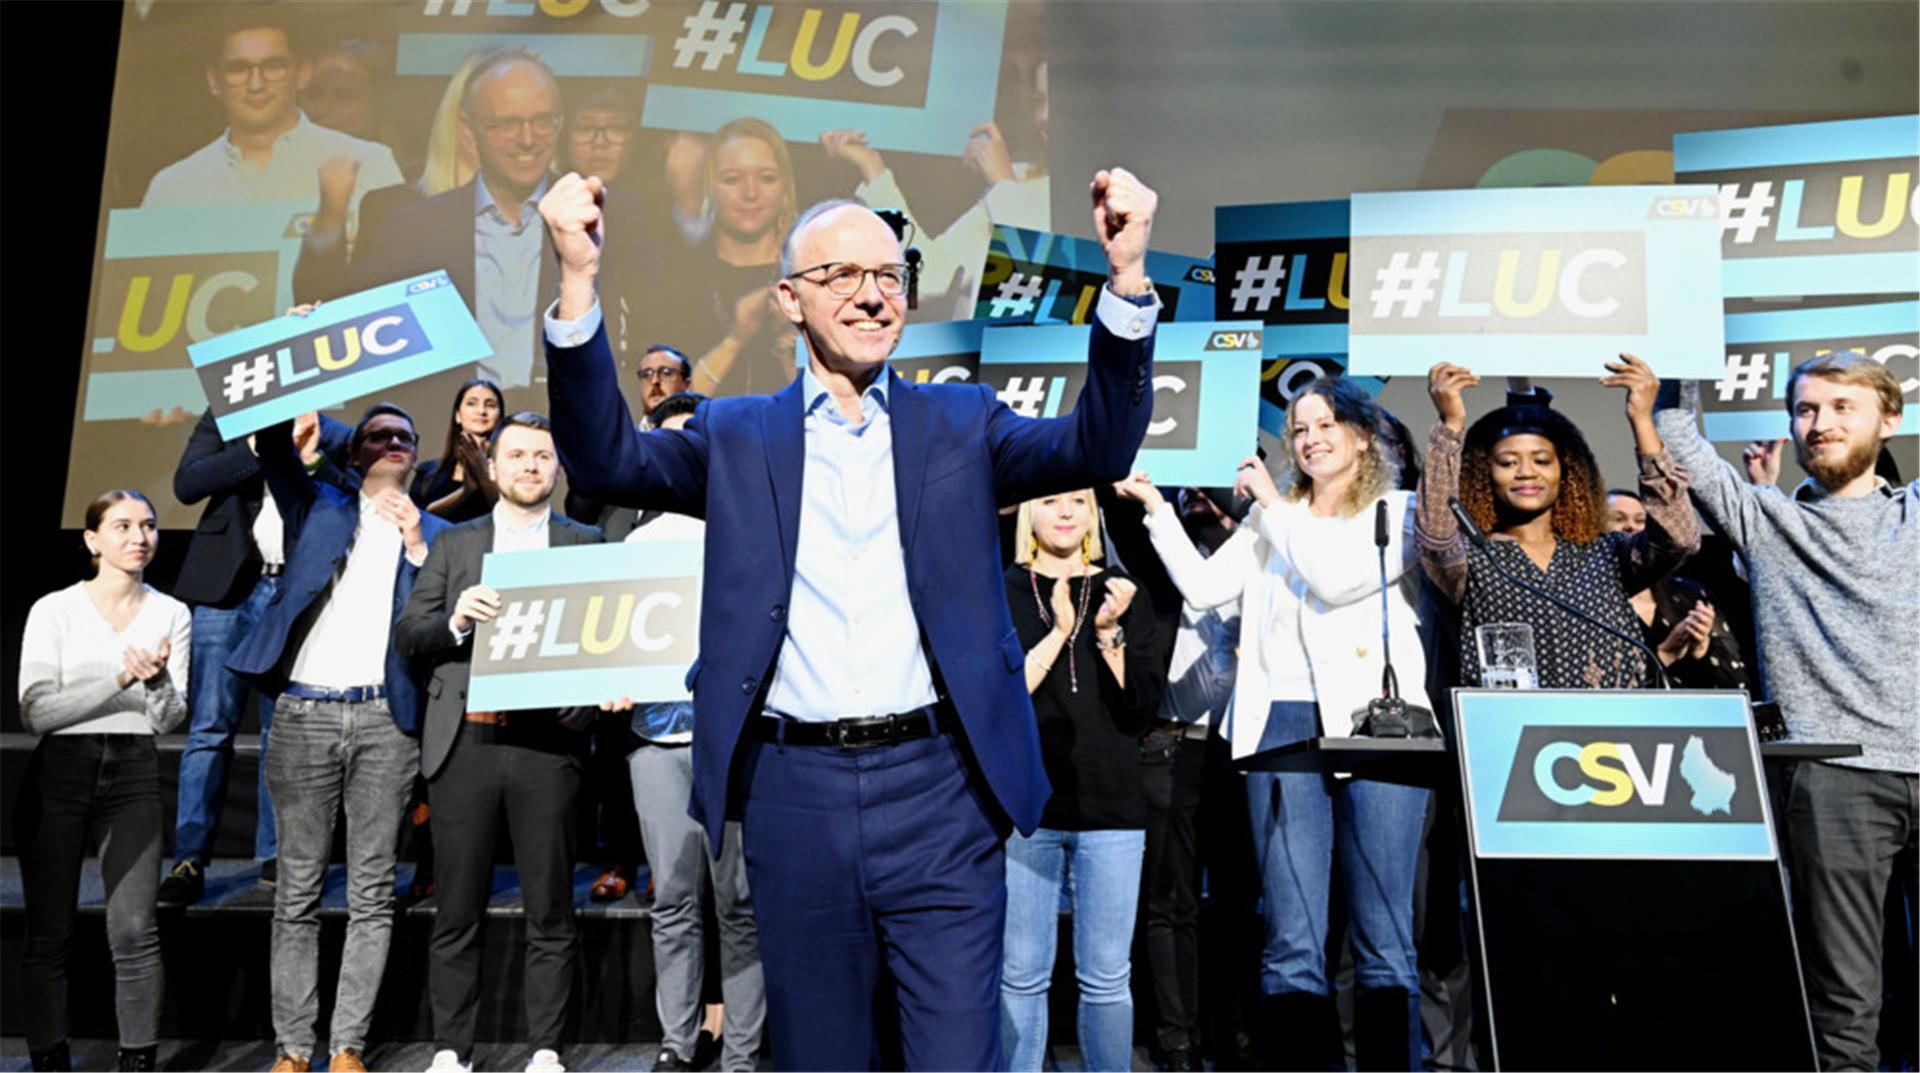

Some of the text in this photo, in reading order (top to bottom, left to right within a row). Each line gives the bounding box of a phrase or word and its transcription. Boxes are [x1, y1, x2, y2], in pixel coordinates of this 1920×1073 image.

[673, 0, 919, 87] #LUC
[1656, 199, 1701, 217] CSV
[1716, 172, 1920, 244] #LU
[1370, 248, 1629, 319] #LUC
[223, 315, 409, 405] #LUC
[1212, 332, 1247, 349] CSV
[488, 591, 684, 661] #LUC
[1533, 741, 1675, 807] CSV
